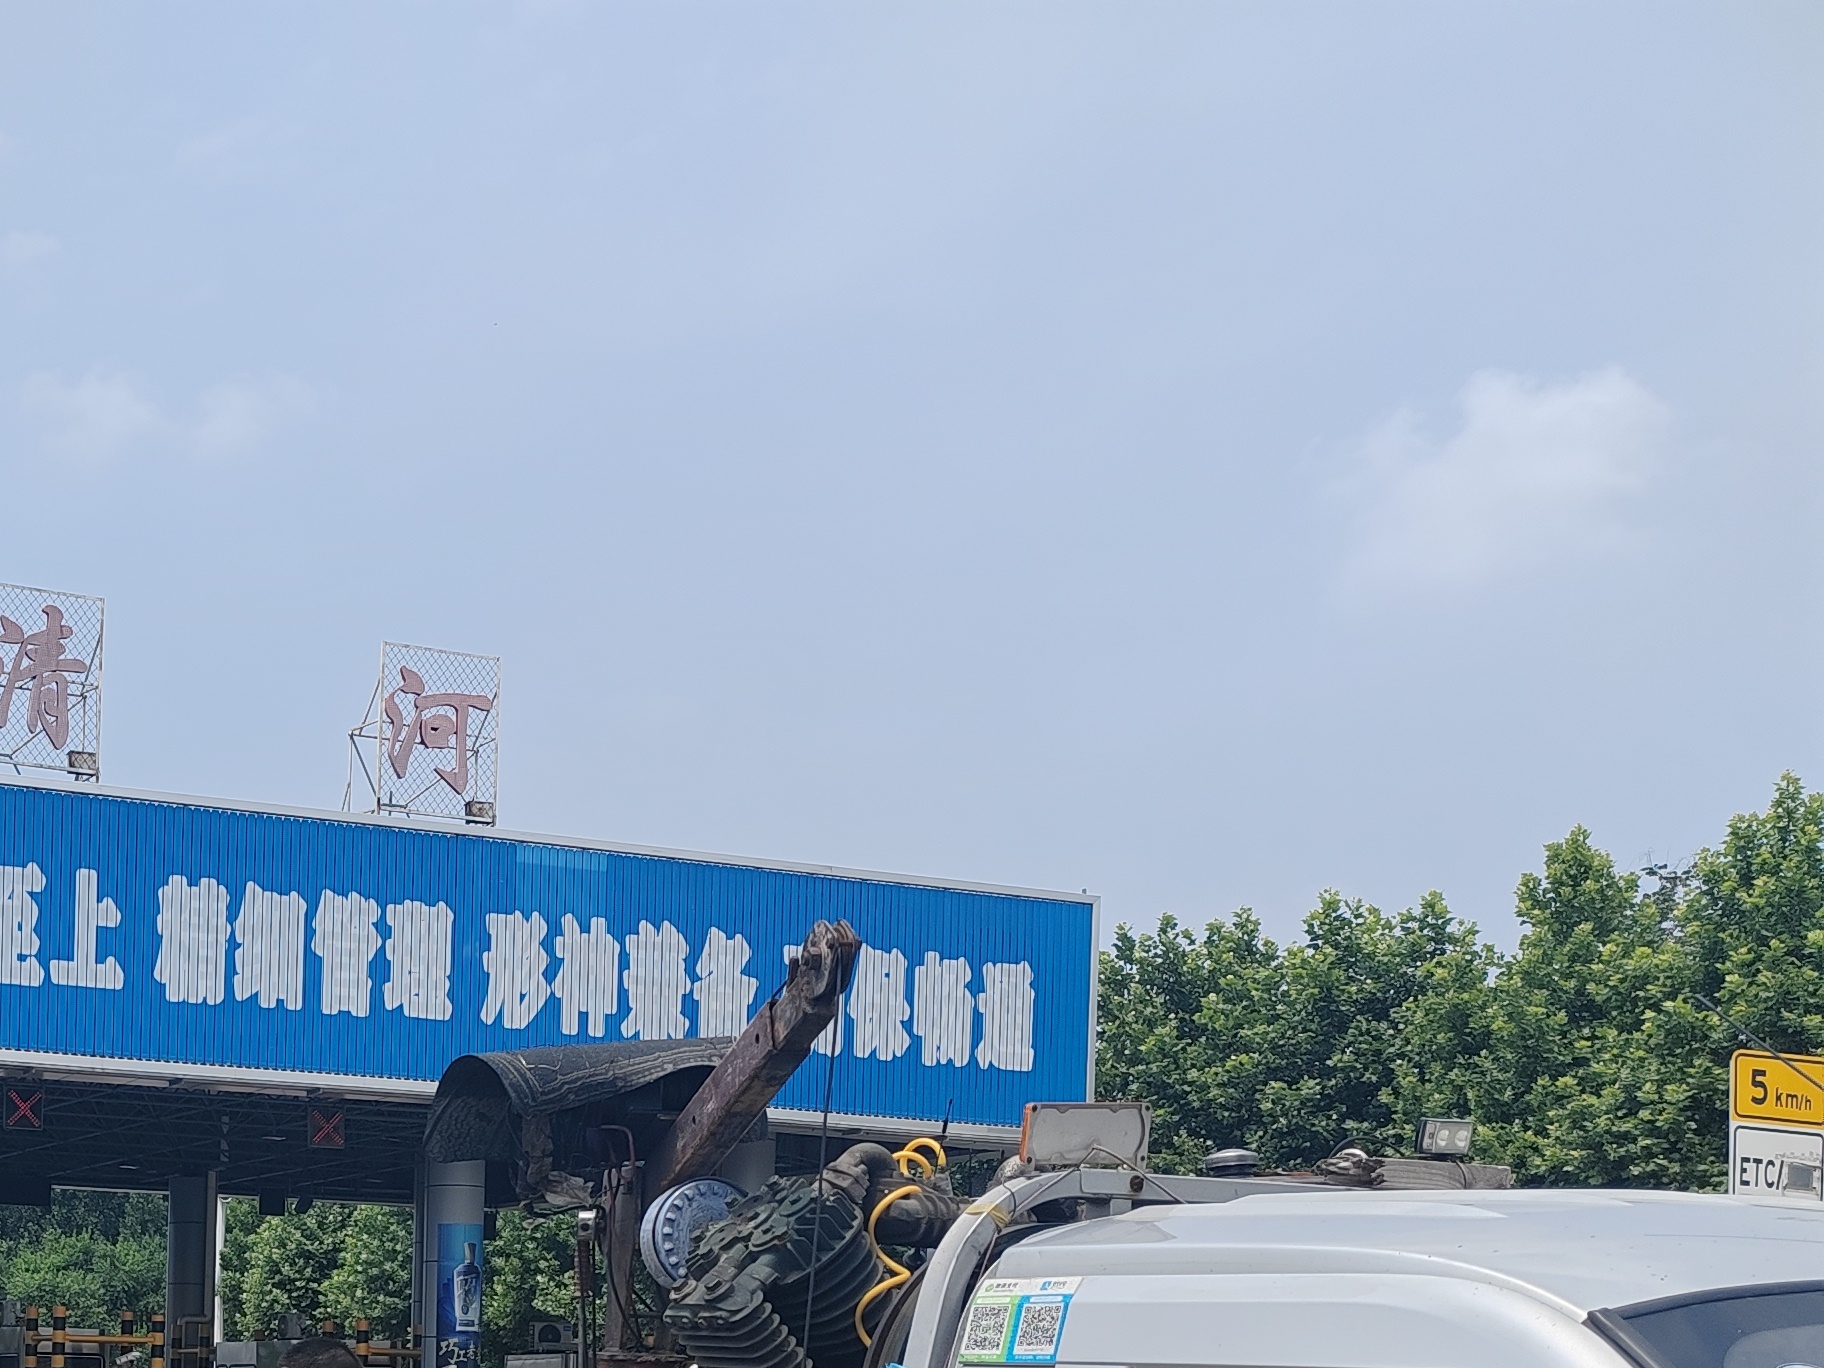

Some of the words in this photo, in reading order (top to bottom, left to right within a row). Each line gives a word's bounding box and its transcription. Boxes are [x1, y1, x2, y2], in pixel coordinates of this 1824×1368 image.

[153, 873, 454, 1022] 精细管理
[479, 910, 758, 1040] 形神兼备
[782, 941, 1036, 1073] 保畅通
[1750, 1068, 1768, 1106] 5
[1774, 1086, 1813, 1112] km/h
